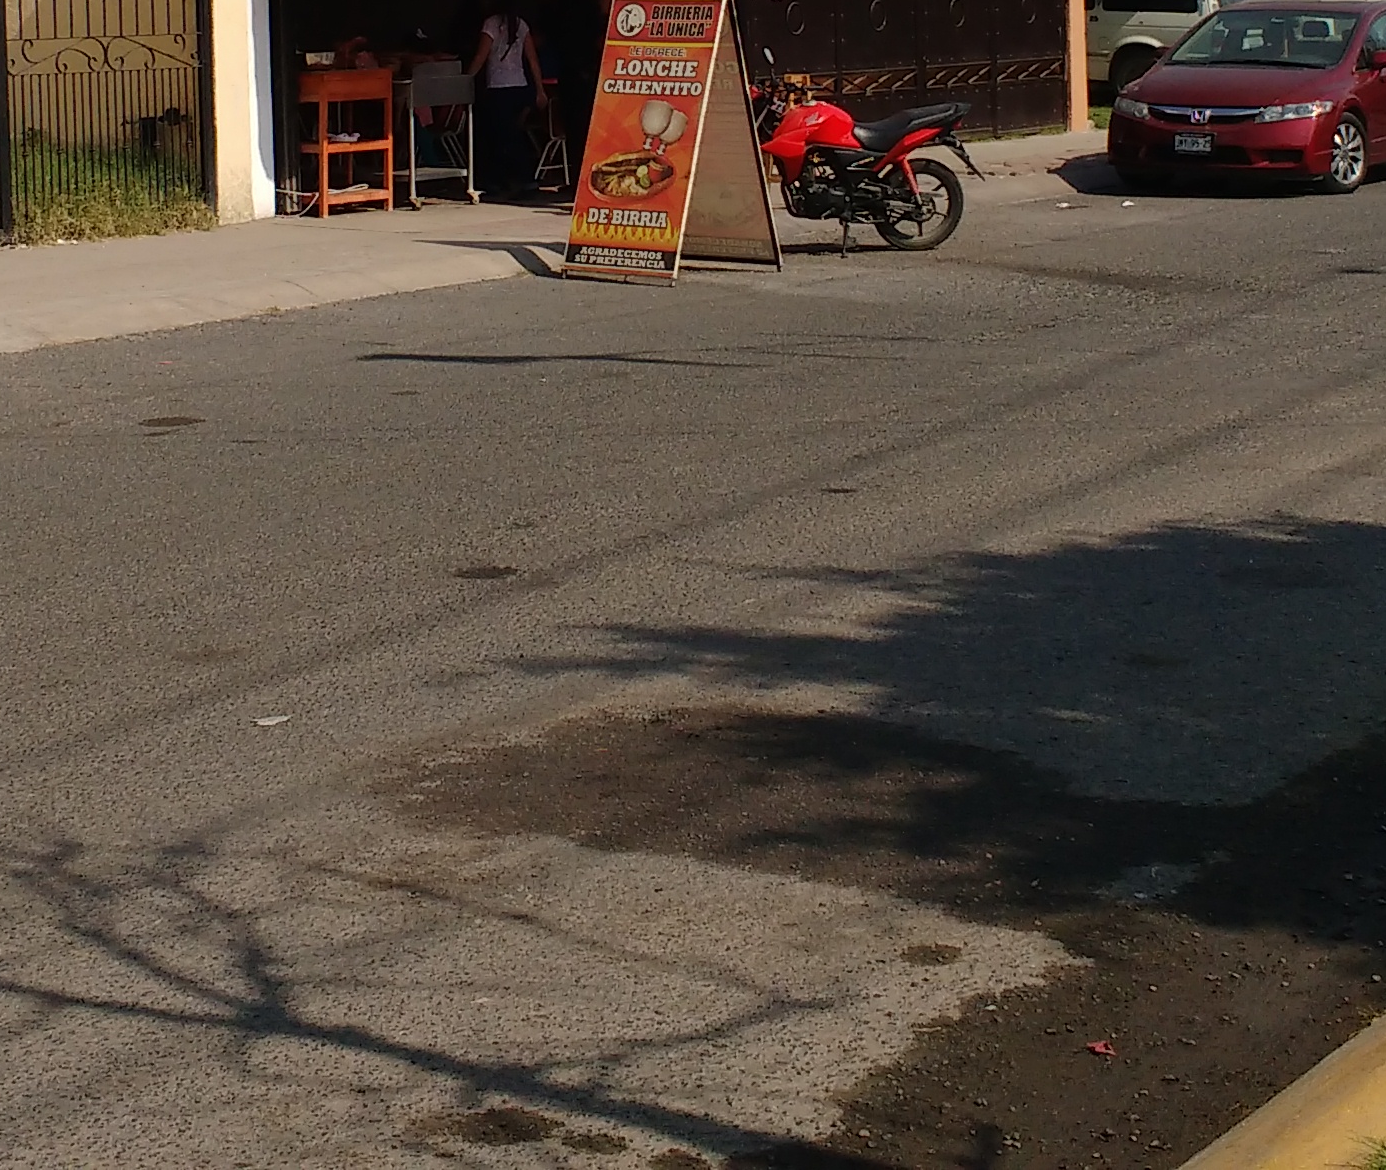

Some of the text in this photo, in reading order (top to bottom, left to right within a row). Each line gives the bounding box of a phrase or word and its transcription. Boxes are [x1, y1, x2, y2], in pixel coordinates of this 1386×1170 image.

[651, 5, 713, 20] BIRRIERIA
[630, 47, 642, 56] LE
[614, 59, 698, 77] LONCHE
[603, 79, 702, 95] CALIENTITO
[587, 208, 667, 227] DE BIRRIA
[580, 246, 662, 260] AGRADECEMOS
[574, 254, 665, 268] SU PREFERENCIA
